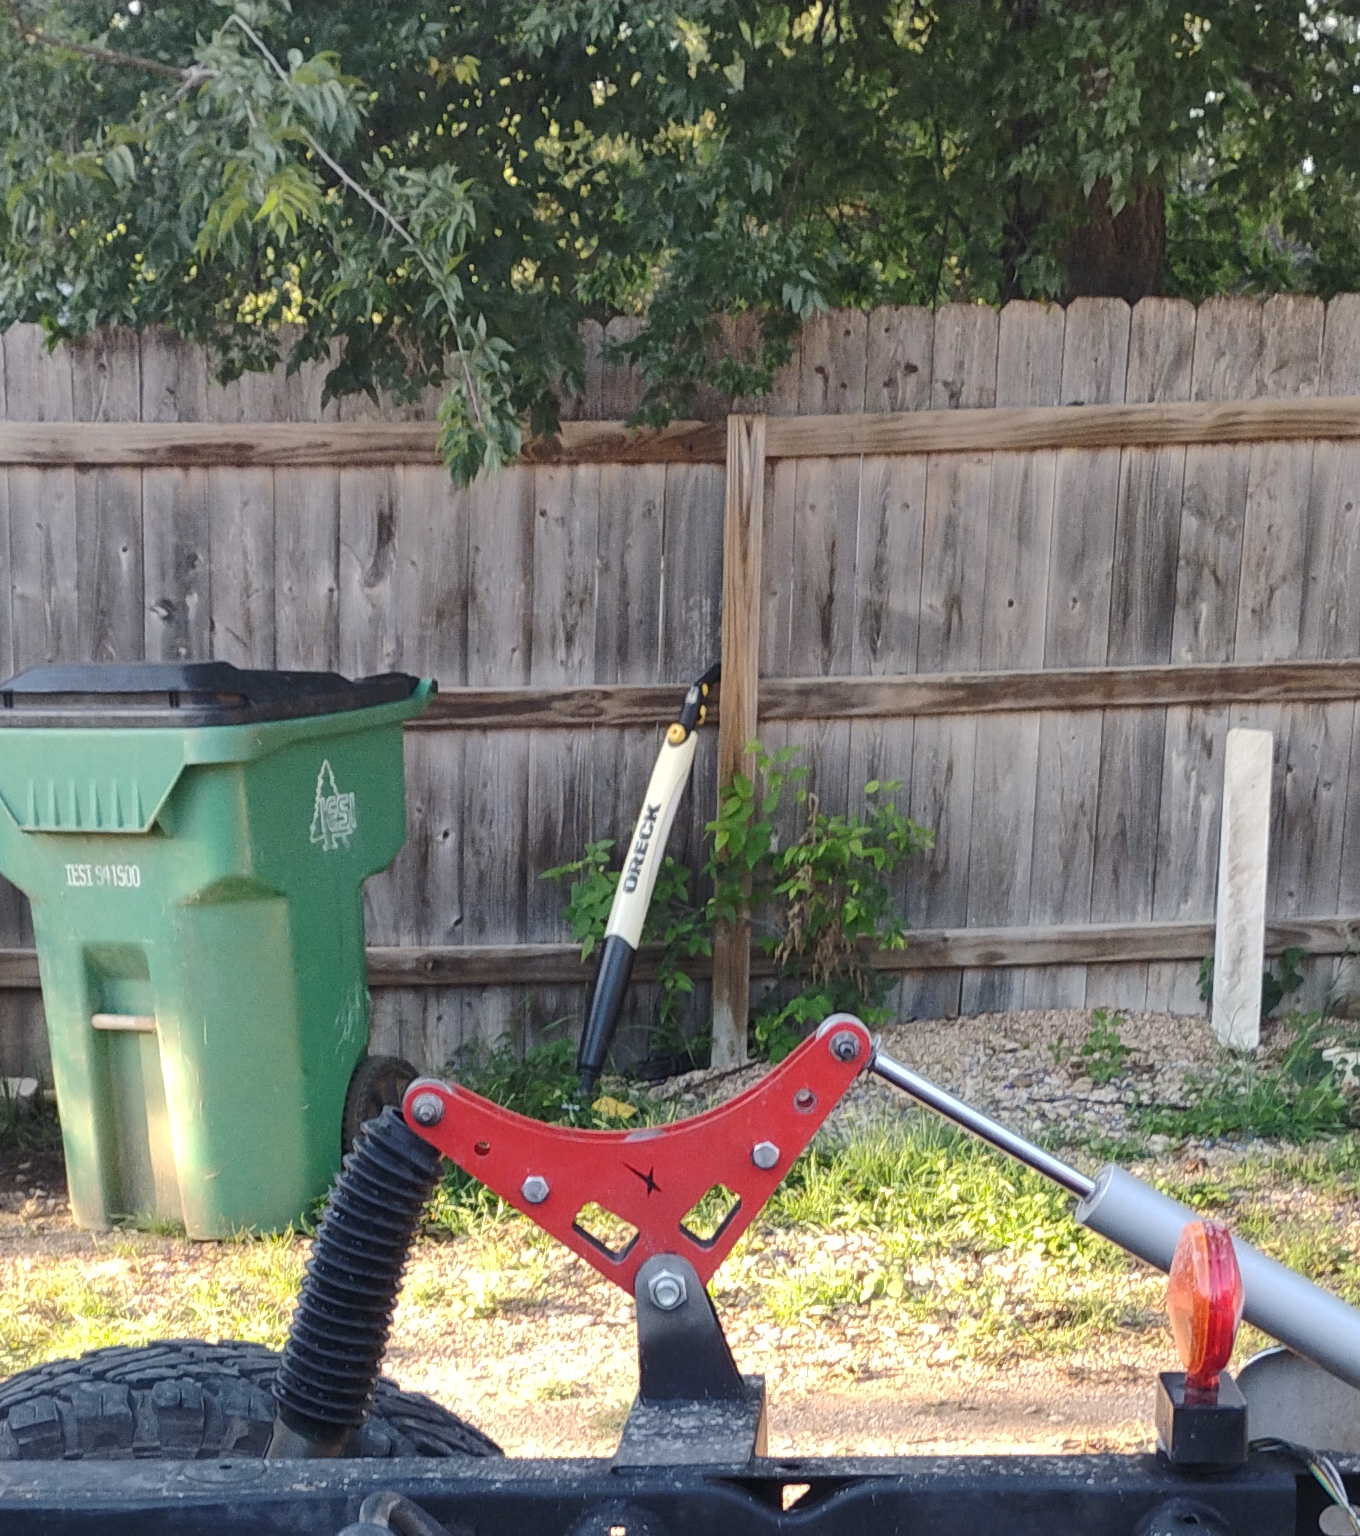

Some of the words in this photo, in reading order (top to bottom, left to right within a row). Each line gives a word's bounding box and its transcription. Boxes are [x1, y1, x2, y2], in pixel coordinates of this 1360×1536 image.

[321, 791, 357, 834] IESI
[623, 803, 661, 894] ORECK
[65, 864, 94, 887] IESI
